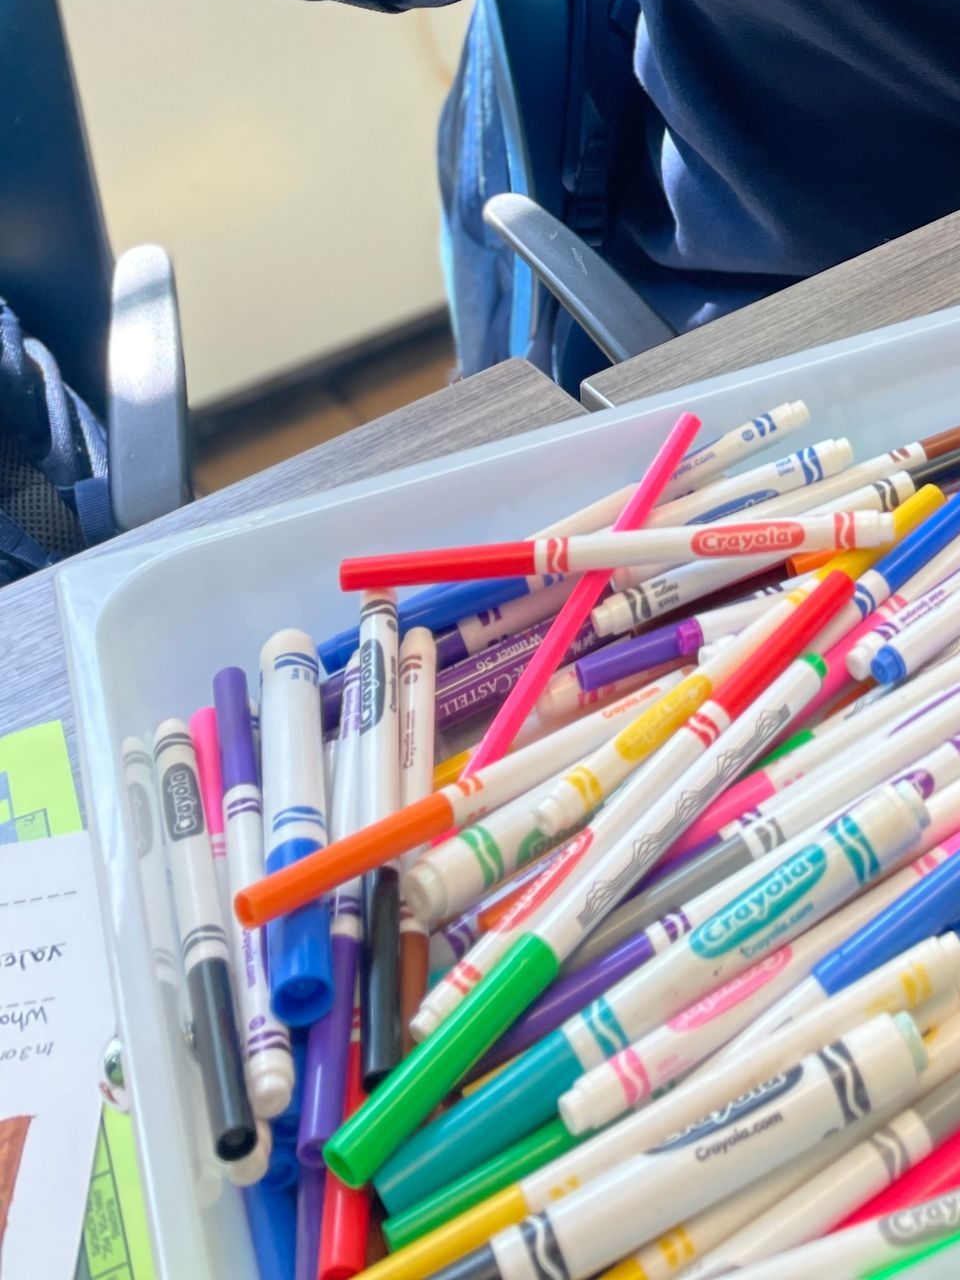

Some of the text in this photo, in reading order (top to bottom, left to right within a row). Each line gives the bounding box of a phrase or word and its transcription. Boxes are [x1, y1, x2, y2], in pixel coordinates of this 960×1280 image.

[699, 524, 796, 554] Crayola
[495, 632, 543, 658] Winner
[360, 648, 381, 728] Crayola
[172, 768, 198, 835] Crayola
[702, 848, 815, 946] Crayola
[0, 1005, 49, 1032] Wha
[694, 1112, 784, 1162] Crayola.com
